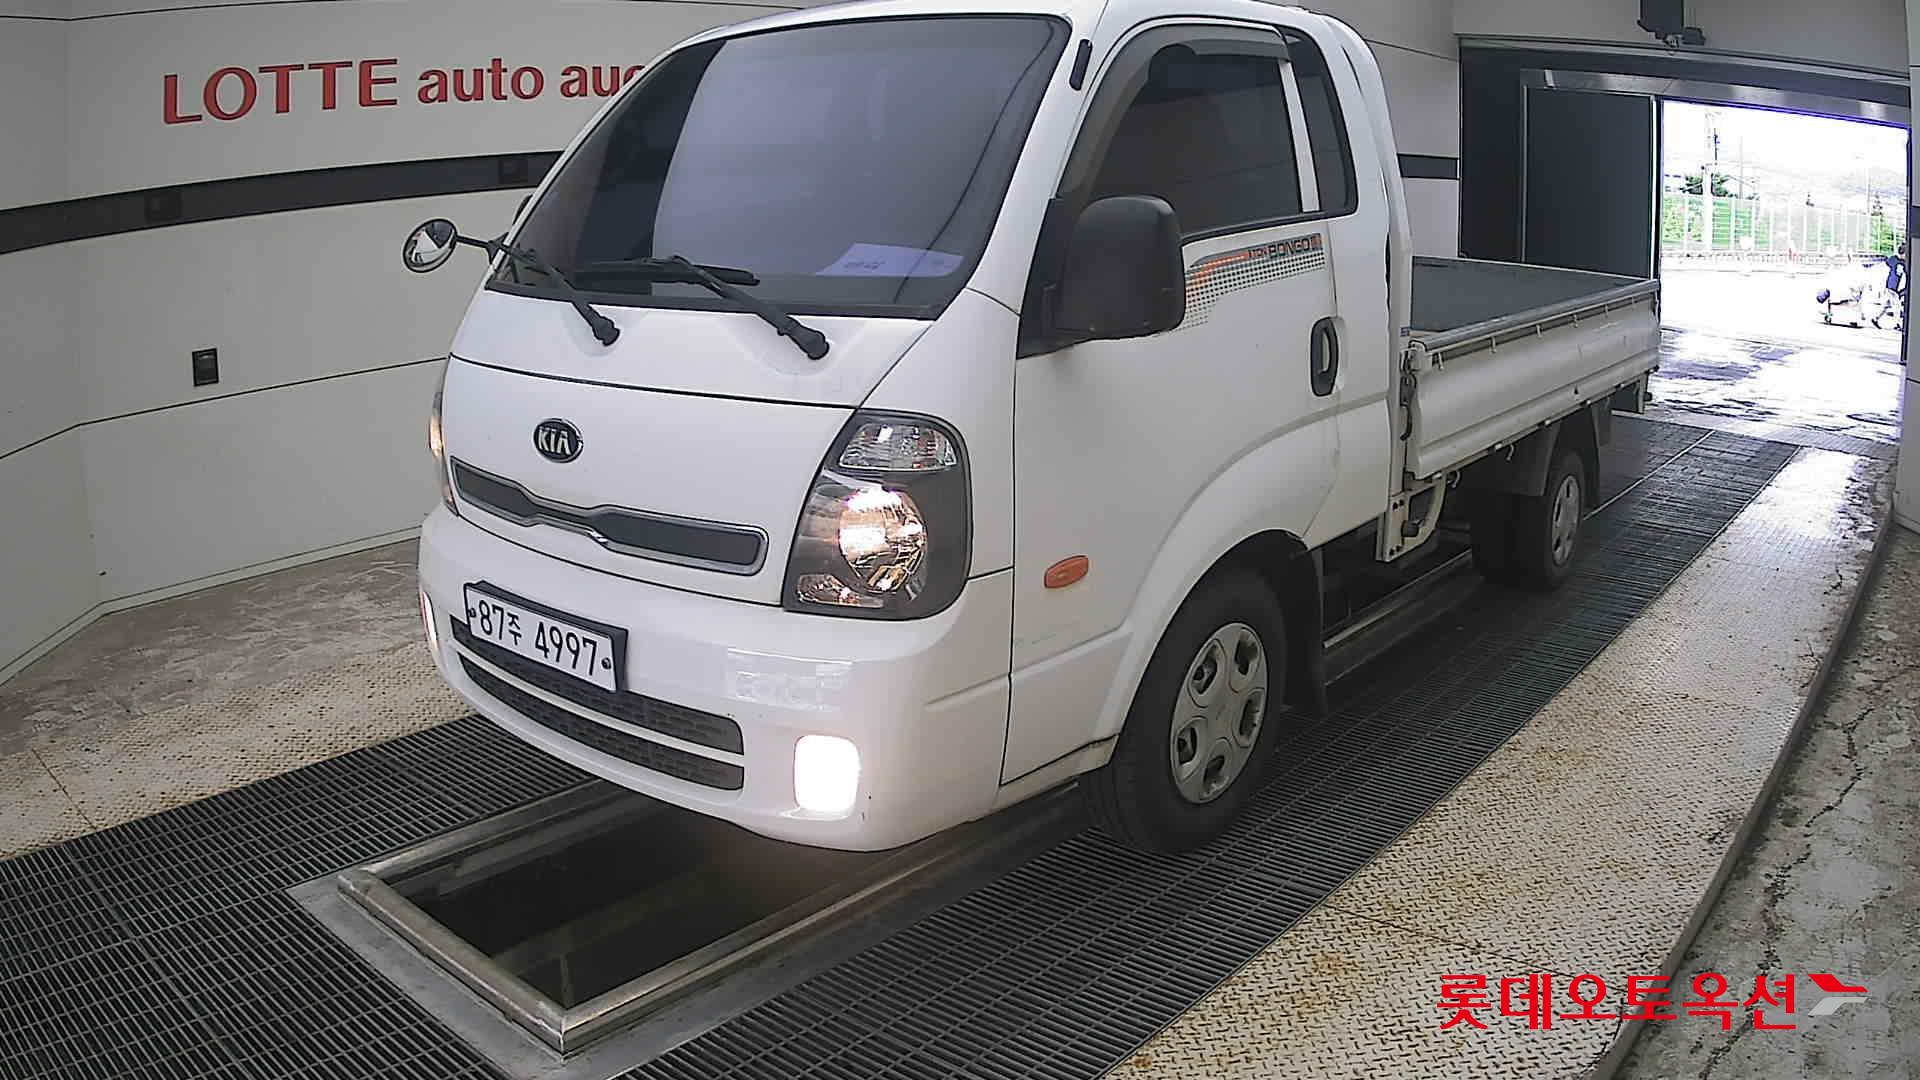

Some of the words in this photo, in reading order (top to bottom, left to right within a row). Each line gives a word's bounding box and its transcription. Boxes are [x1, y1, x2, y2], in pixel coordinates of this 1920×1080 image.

[163, 58, 399, 125] LOTTE
[417, 57, 545, 104] auto
[538, 426, 571, 456] KIA
[478, 599, 522, 646] 87주
[535, 621, 598, 677] 4997
